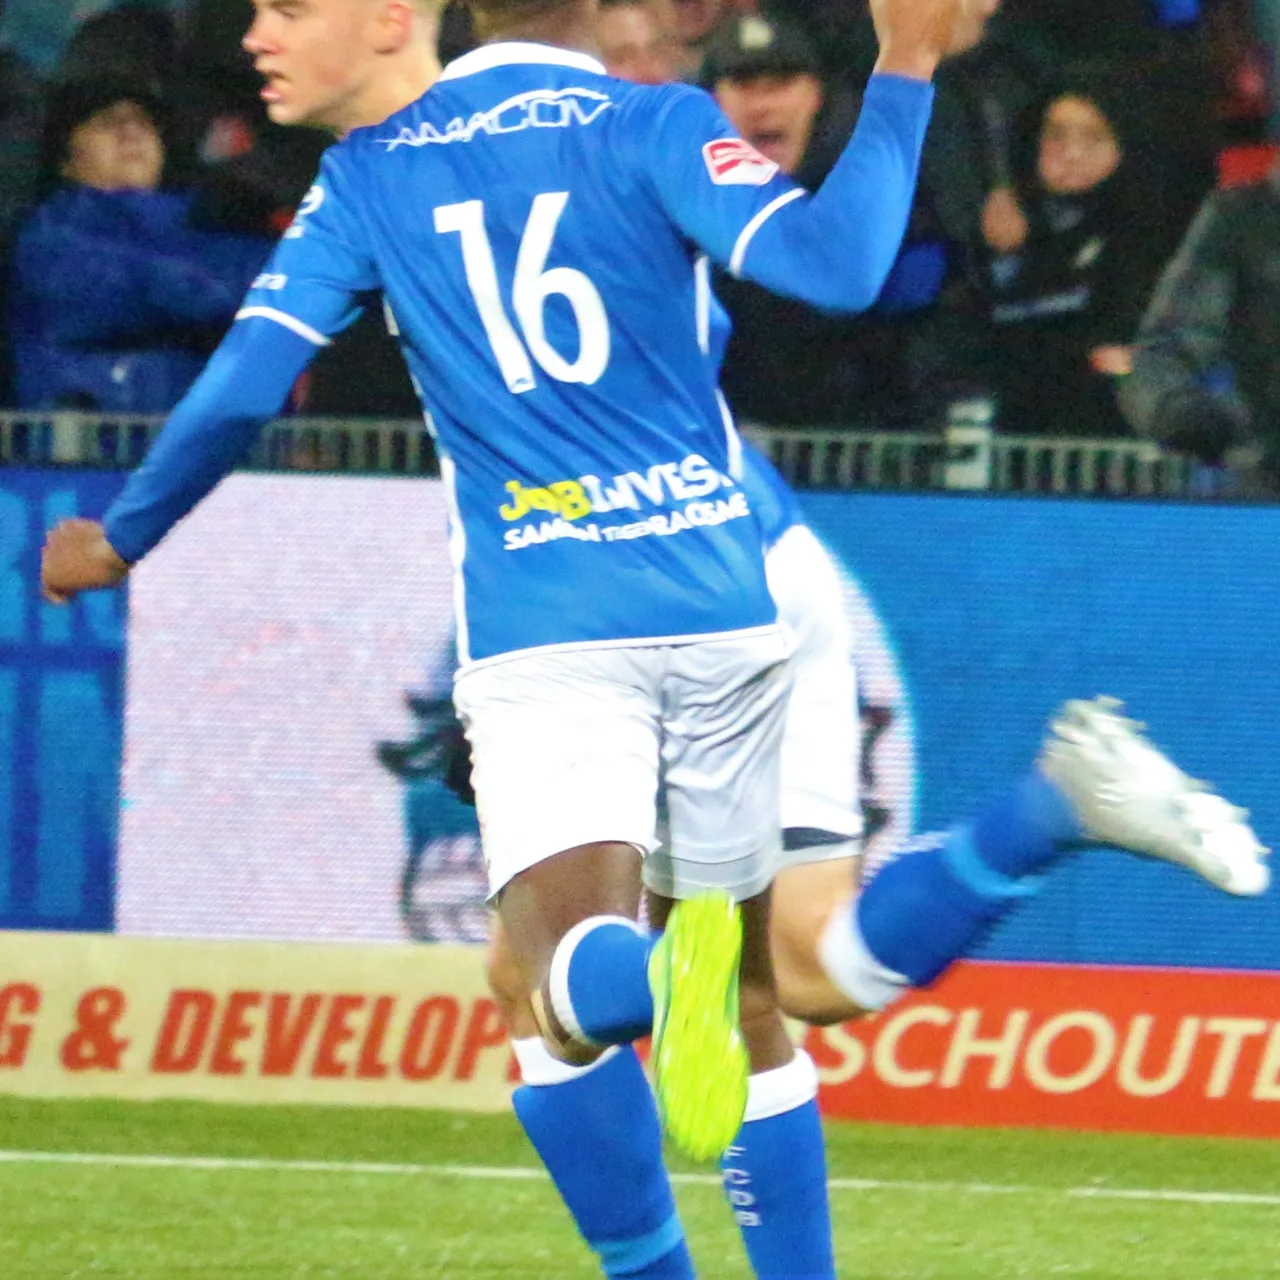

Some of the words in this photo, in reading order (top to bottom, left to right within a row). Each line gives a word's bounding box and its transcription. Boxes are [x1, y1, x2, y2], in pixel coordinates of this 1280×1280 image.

[433, 191, 611, 394] 16
[499, 453, 734, 521] JOBINVES
[150, 988, 512, 1083] DEVELOP
